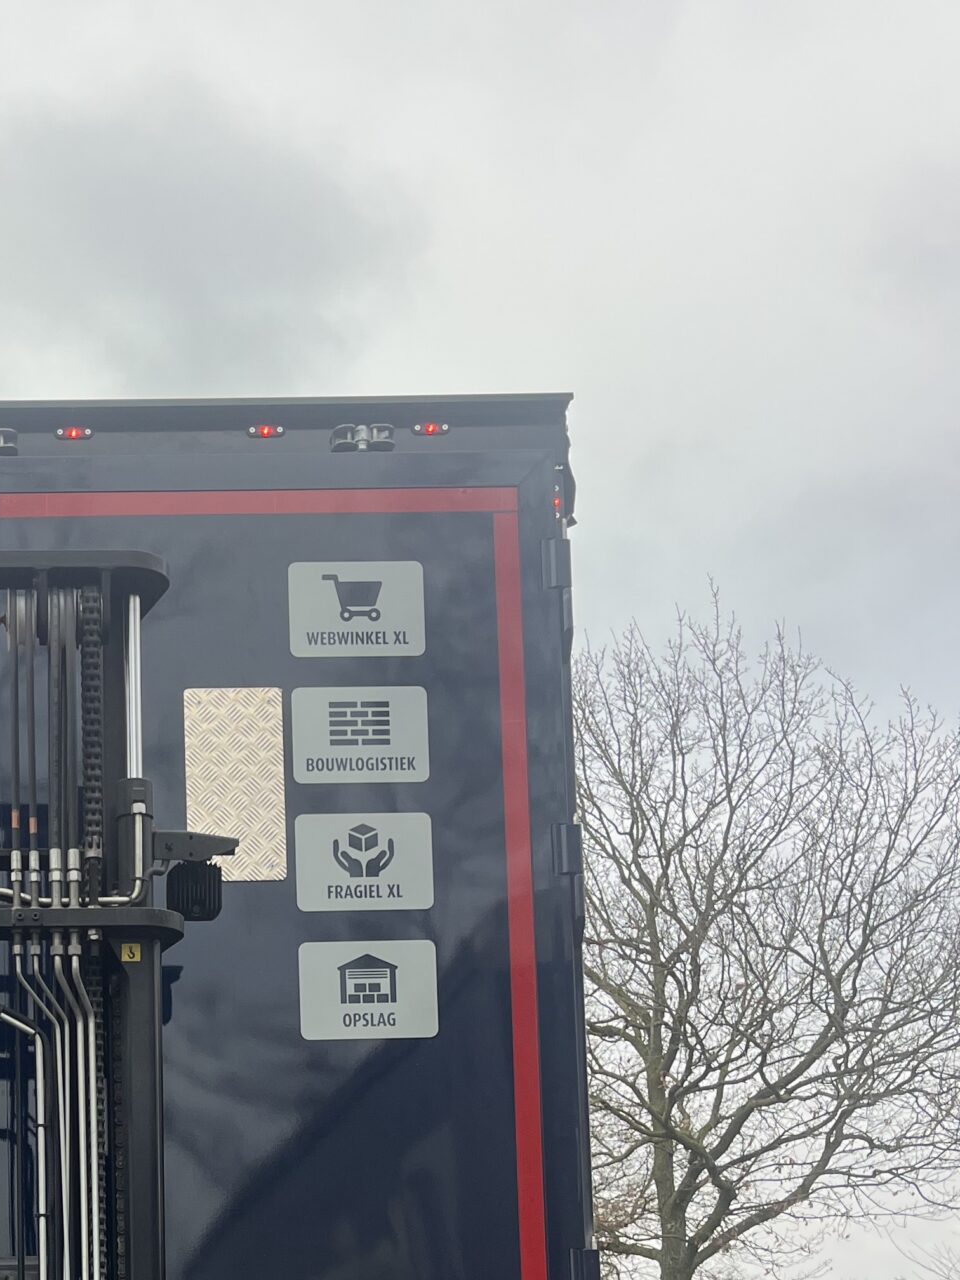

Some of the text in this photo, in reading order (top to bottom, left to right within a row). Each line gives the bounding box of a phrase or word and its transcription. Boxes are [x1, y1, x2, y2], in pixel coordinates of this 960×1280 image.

[306, 631, 409, 645] WEBWINKEL XL
[306, 756, 416, 772] BOUWLOGISTIEK
[327, 884, 403, 899] FRAGIEL XL
[343, 1012, 396, 1027] OPSLAG
